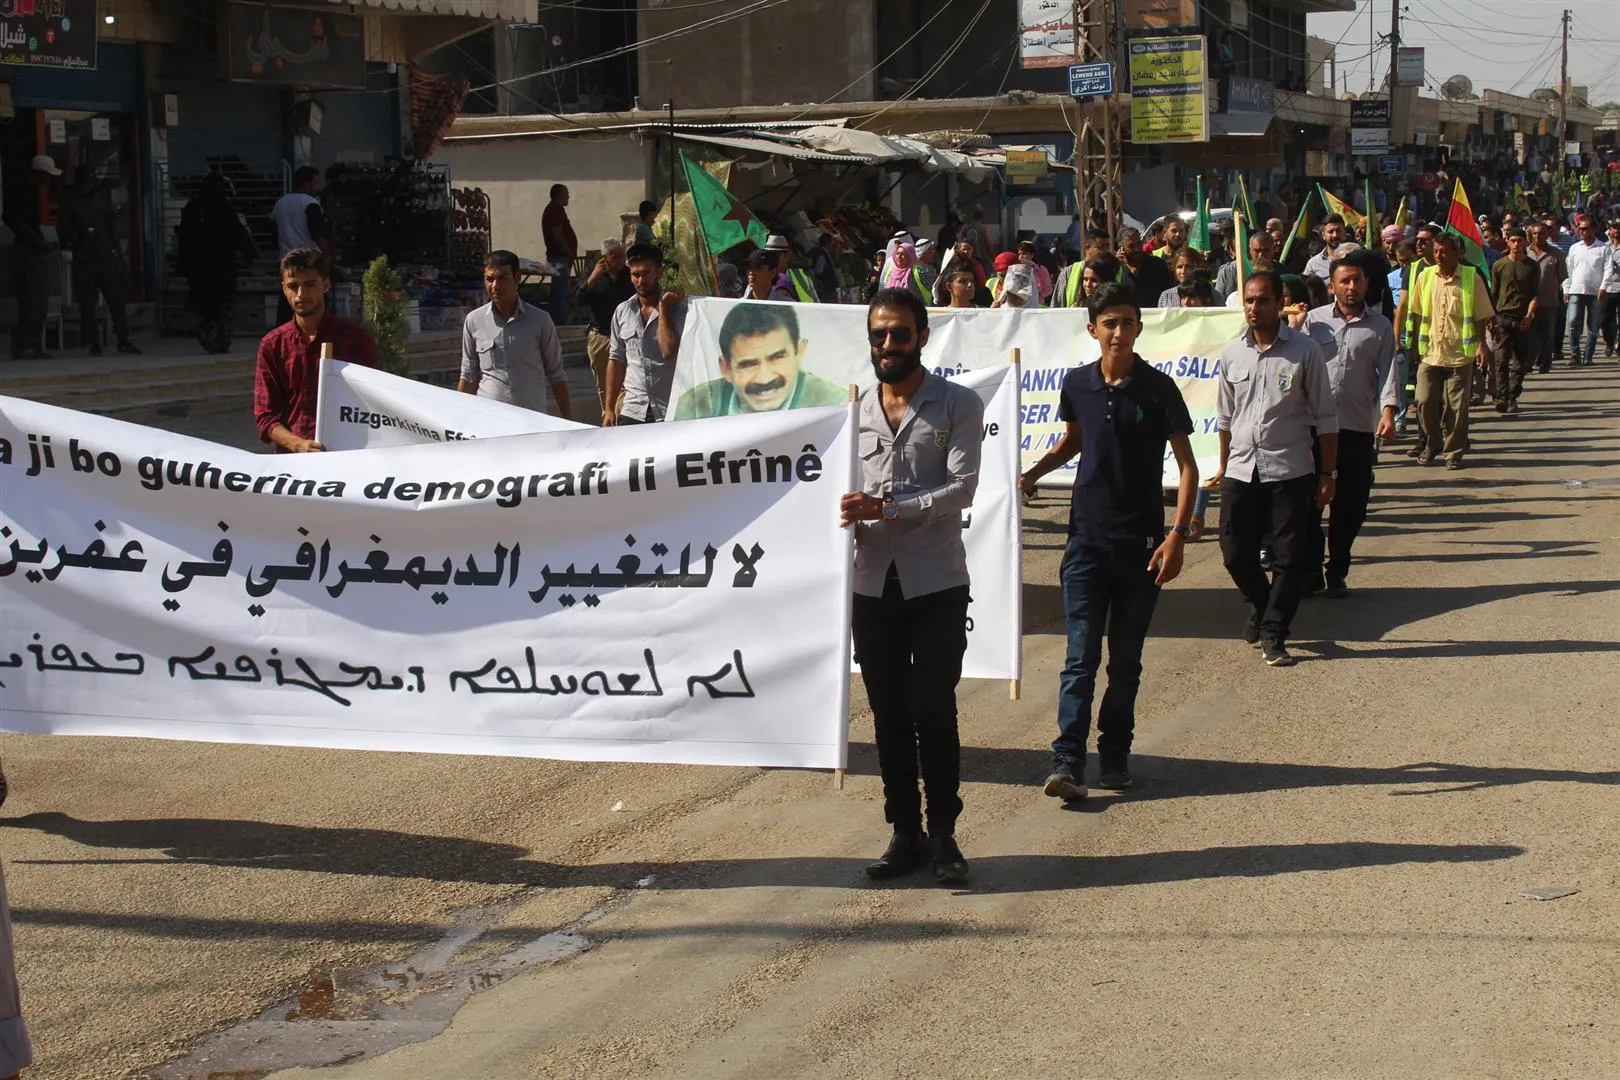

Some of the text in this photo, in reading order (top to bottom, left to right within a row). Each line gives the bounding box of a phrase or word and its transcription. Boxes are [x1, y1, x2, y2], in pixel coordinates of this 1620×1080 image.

[1042, 20, 1074, 35] سماعيل
[1020, 367, 1073, 392] ANKI
[26, 434, 55, 476] ji
[70, 439, 121, 476] bo
[138, 455, 344, 497] guherîna
[364, 461, 608, 508] demografî
[629, 457, 656, 492] li
[676, 444, 822, 488] Efrînê
[0, 519, 765, 617] لا للتغيير الديمغرافي في عفرين
